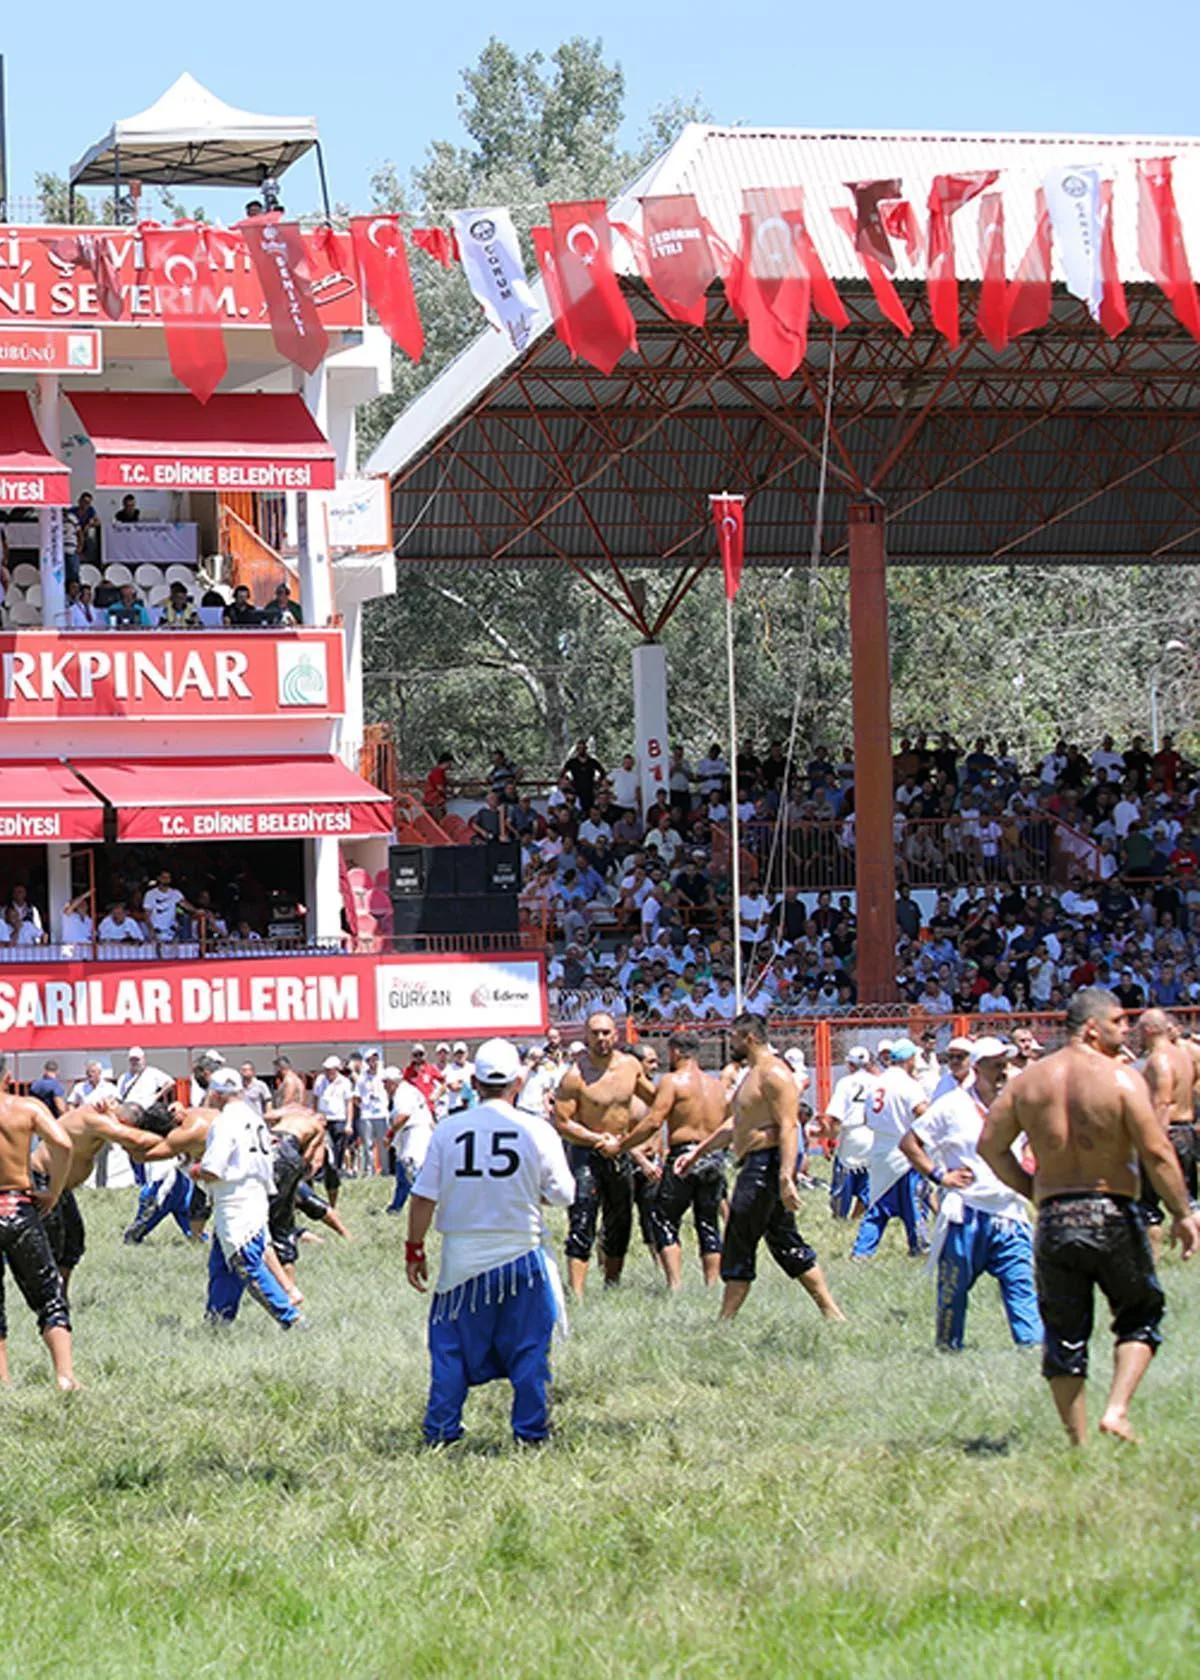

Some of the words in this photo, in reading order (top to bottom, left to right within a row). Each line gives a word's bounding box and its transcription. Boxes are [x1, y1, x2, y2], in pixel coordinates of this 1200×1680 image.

[120, 464, 150, 483] T.C.
[154, 462, 214, 485] EDİRNE
[218, 463, 311, 487] BELEDİYESİ
[160, 816, 189, 835] T.C.
[194, 811, 254, 834] EDİRNE
[258, 808, 351, 833] BELEDİYESİ
[181, 975, 360, 1023] DİLERİM
[872, 1087, 886, 1115] 3
[455, 1130, 520, 1178] 15
